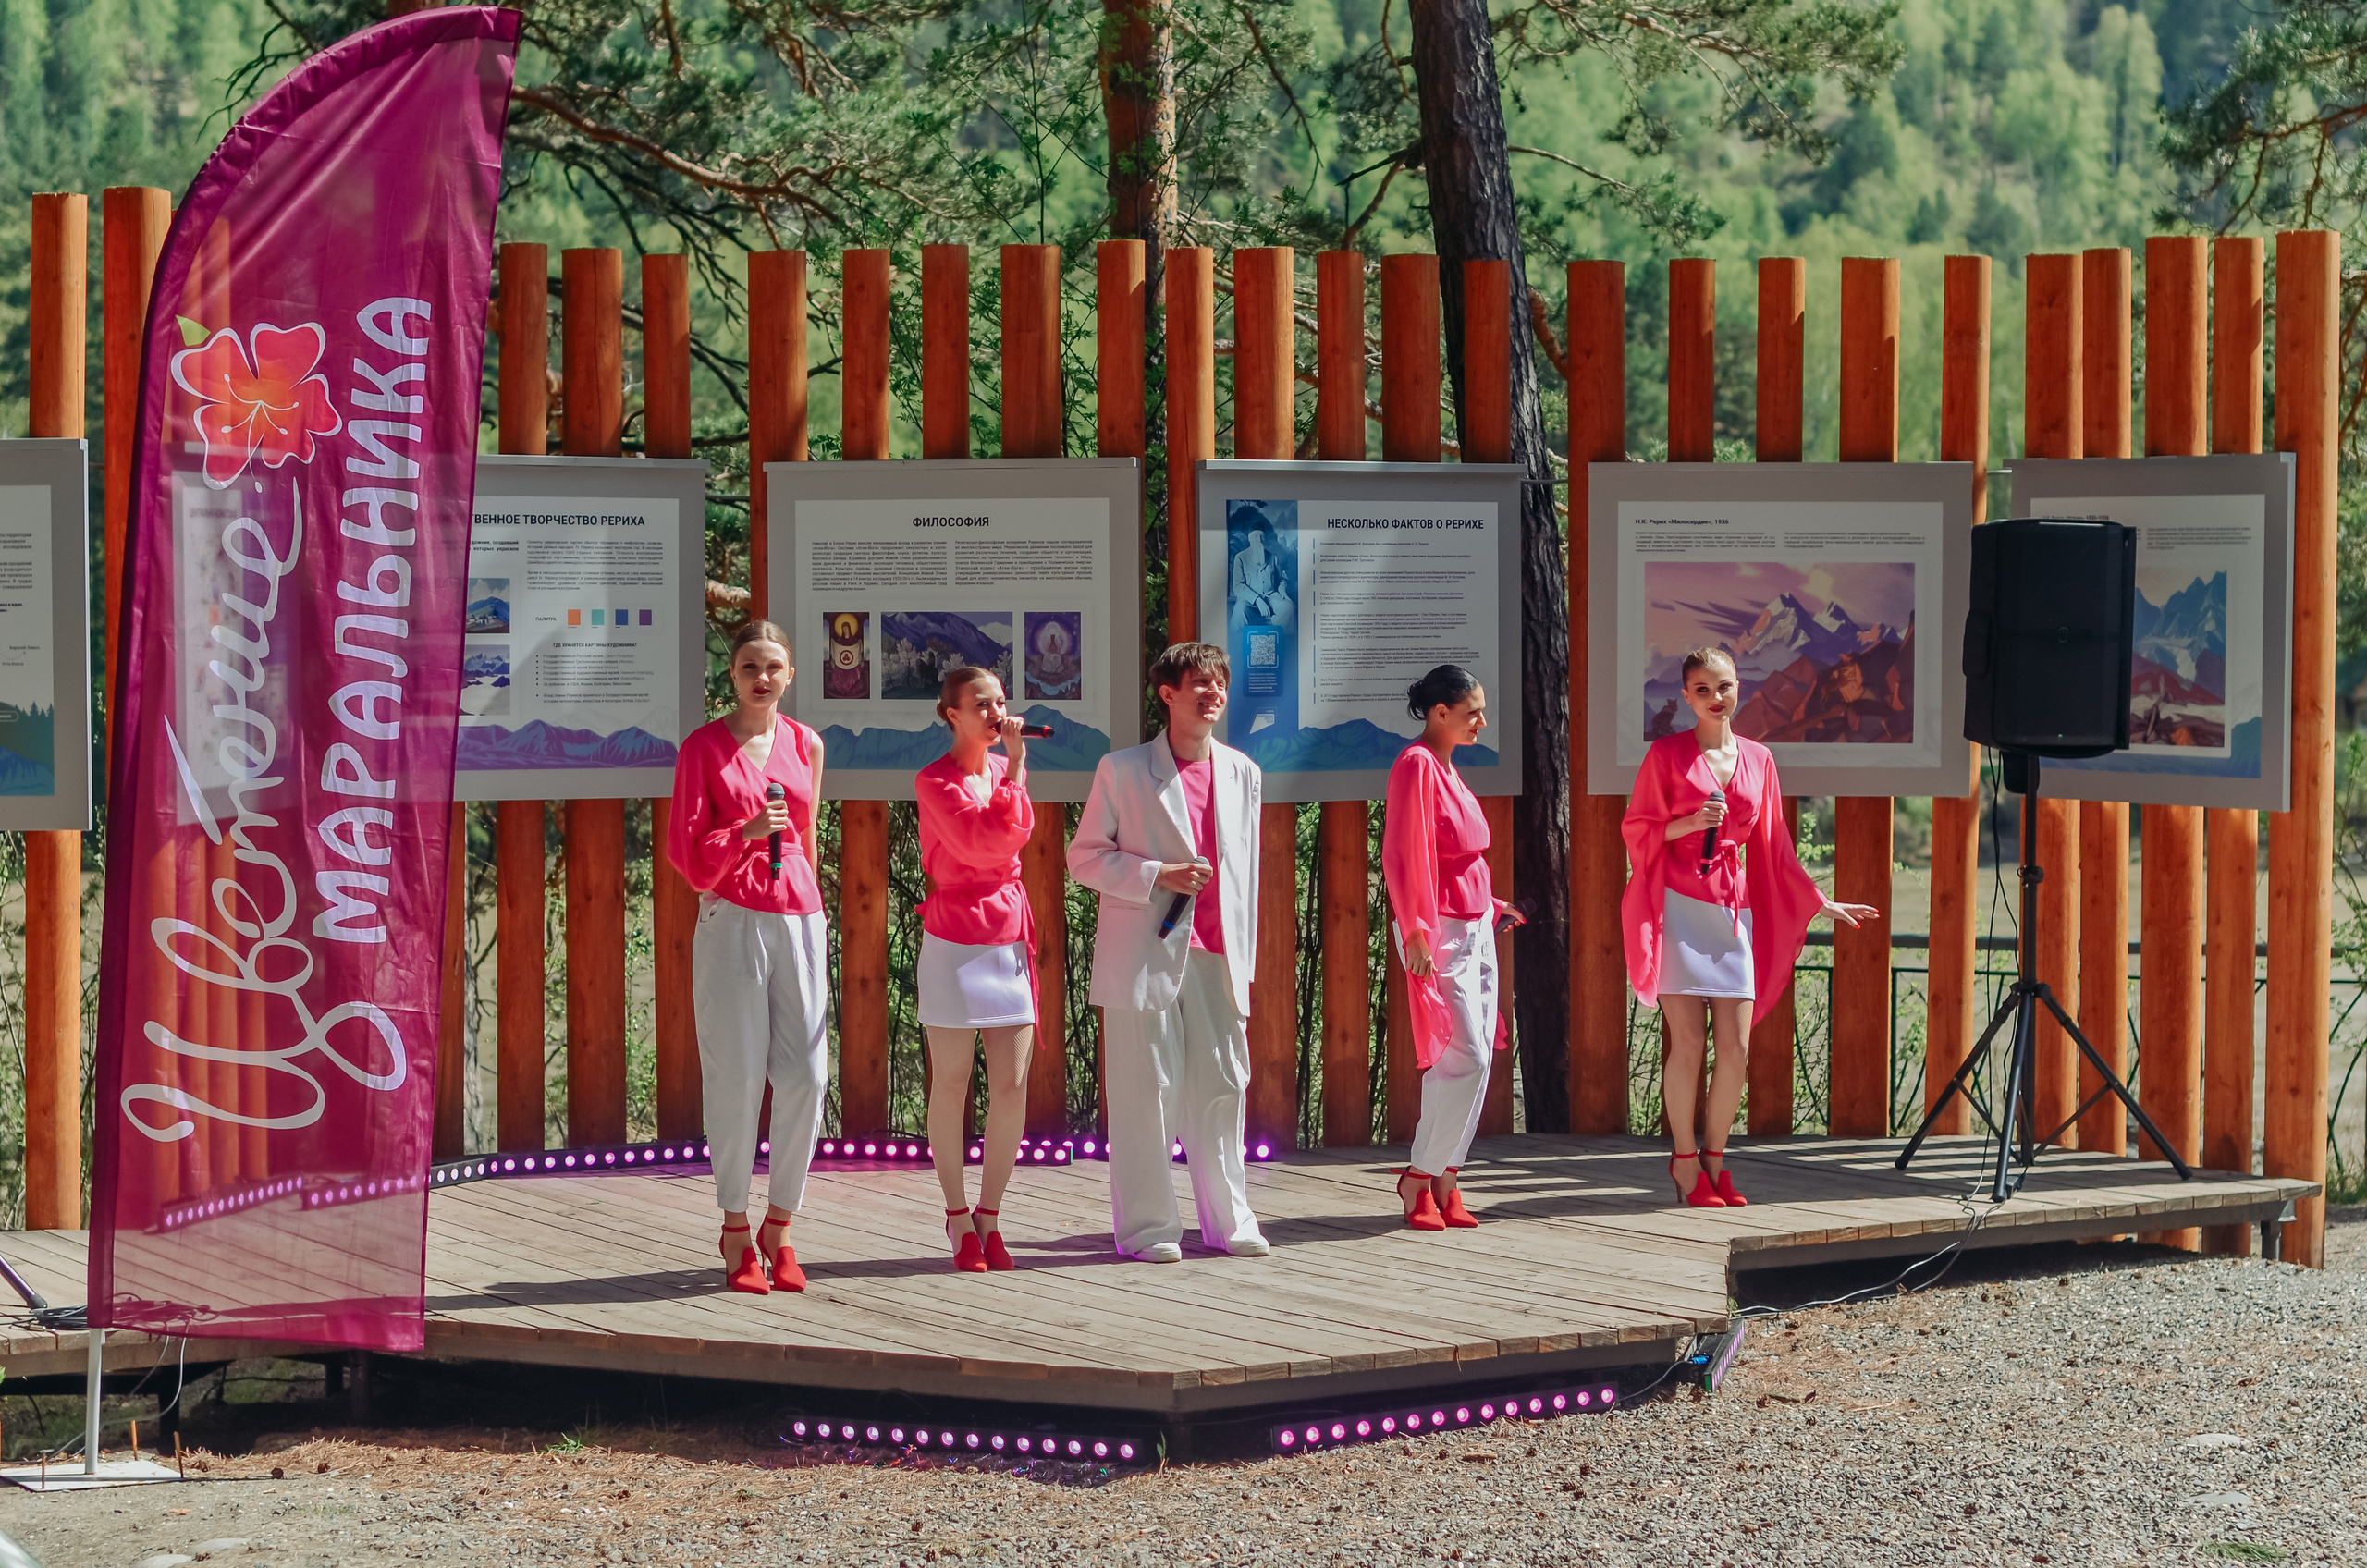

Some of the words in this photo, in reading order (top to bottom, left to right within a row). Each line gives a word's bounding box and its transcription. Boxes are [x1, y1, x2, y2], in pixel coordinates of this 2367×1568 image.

[470, 514, 520, 524] ВЕННОЕ
[523, 515, 598, 525] ТВОРЧЕСТВО
[600, 516, 645, 526] РЕРИХА
[912, 517, 989, 527] ФИЛОСОФИЯ
[1327, 518, 1389, 529] НЕСКОЛЬКО
[1392, 519, 1433, 529] ФАКТОВ
[1436, 519, 1443, 529] О
[1445, 519, 1484, 529] РЕРИХЕ
[312, 296, 432, 943] МАРАЛЬНИКА
[121, 474, 407, 1143] Цветение
